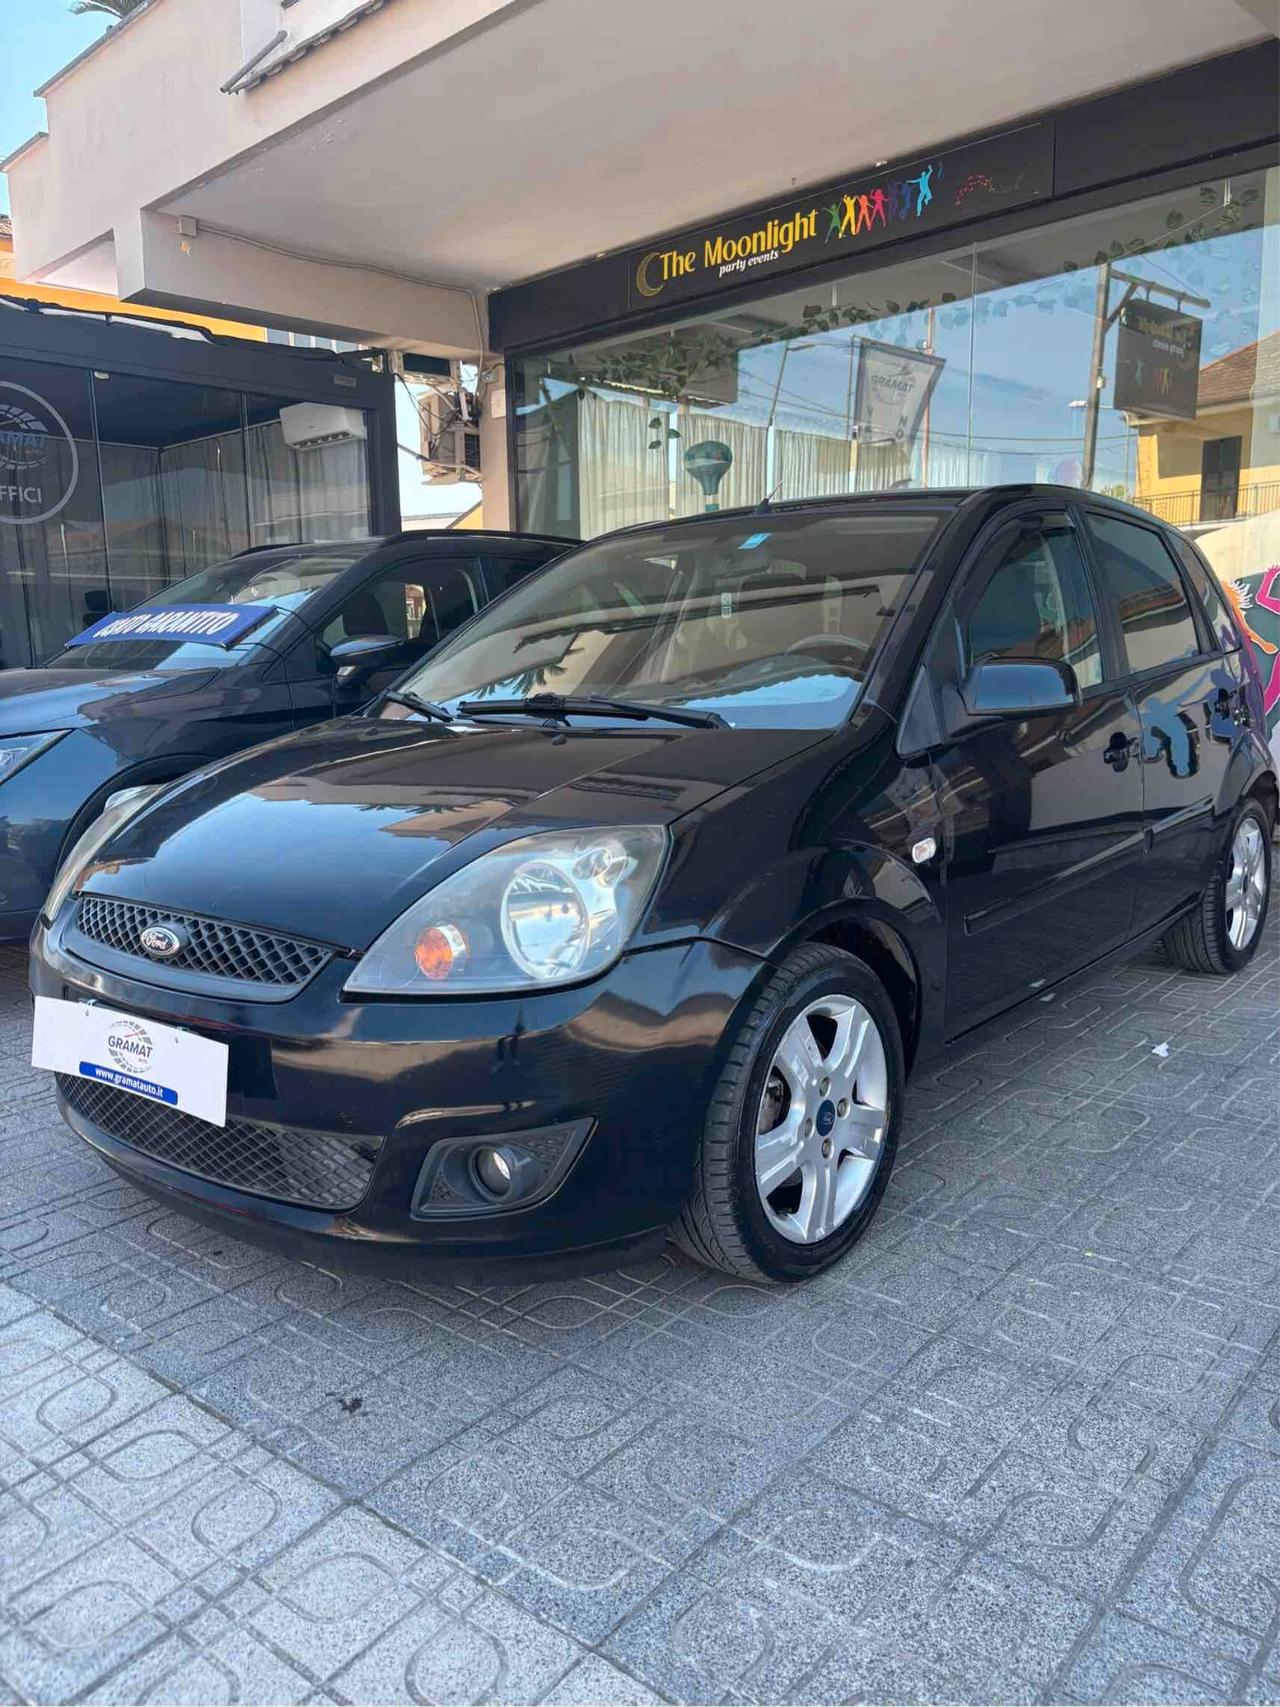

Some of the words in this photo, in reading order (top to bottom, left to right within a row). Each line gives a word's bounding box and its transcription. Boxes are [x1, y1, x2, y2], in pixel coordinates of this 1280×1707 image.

[660, 250, 696, 281] The
[704, 208, 818, 268] Moonlight
[719, 259, 746, 278] party
[747, 249, 779, 267] events
[145, 931, 169, 950] Ford
[108, 1035, 153, 1059] GRAMAT
[95, 1067, 163, 1097] www.gramatauto.it
